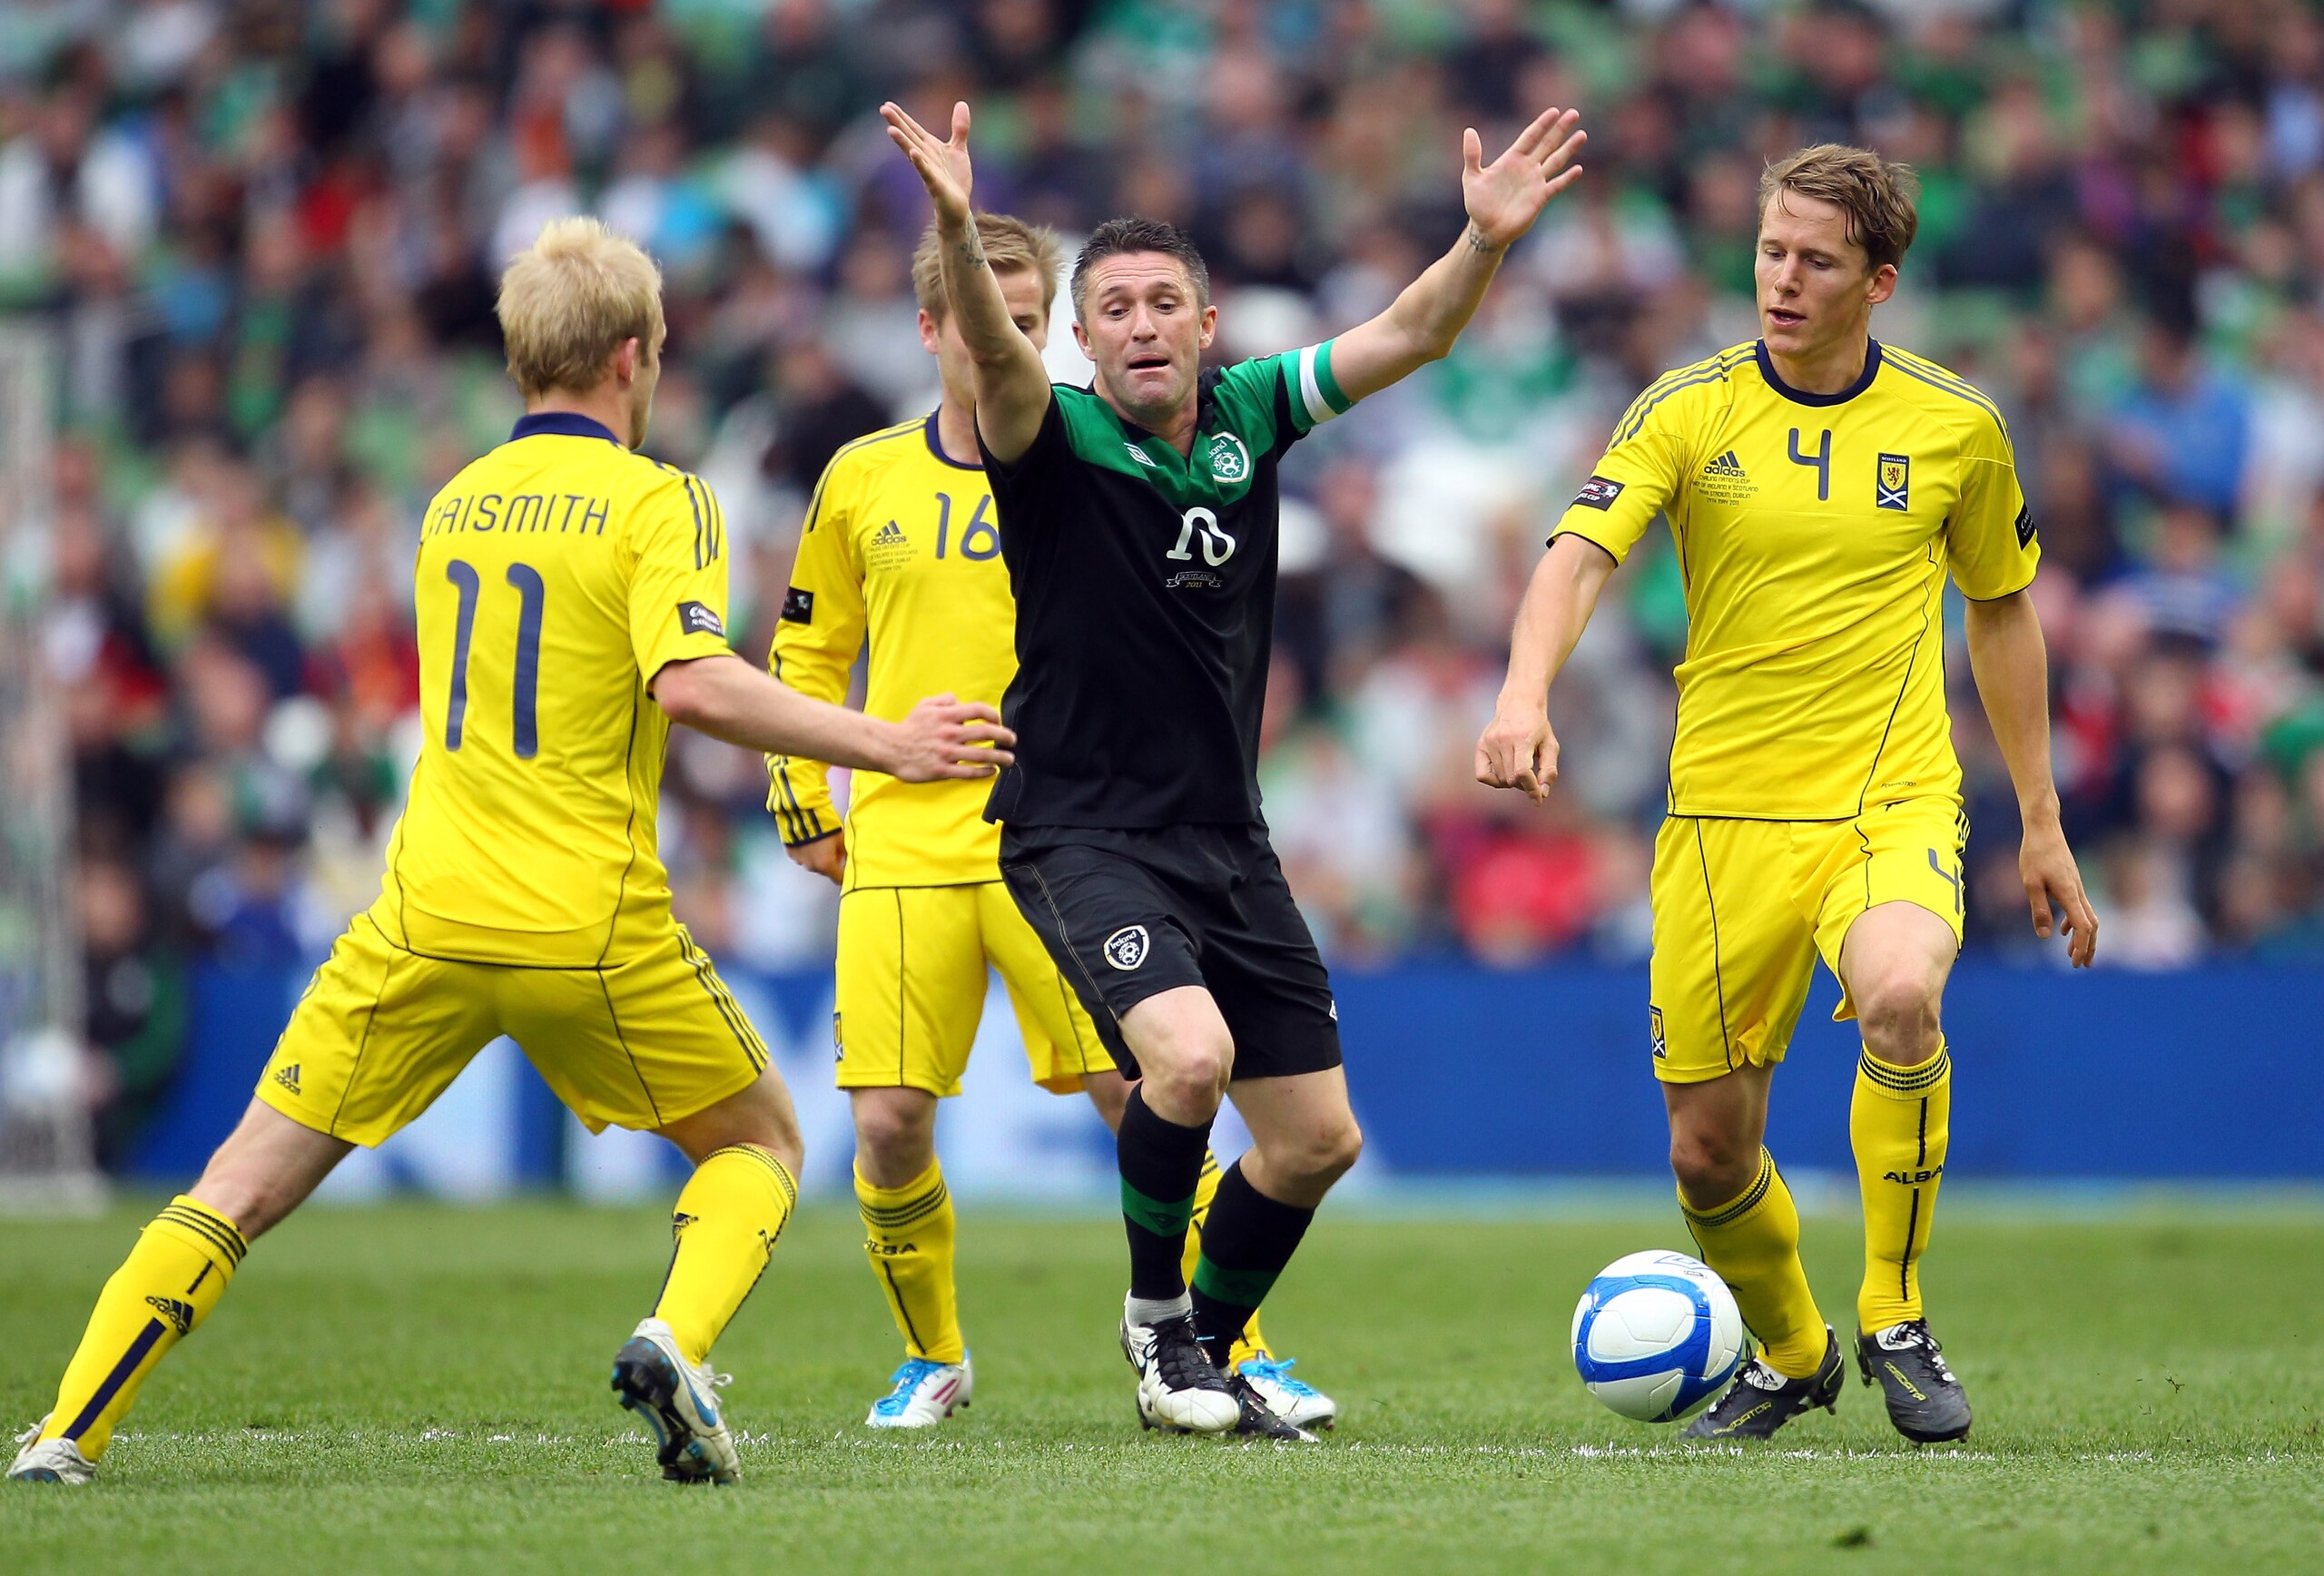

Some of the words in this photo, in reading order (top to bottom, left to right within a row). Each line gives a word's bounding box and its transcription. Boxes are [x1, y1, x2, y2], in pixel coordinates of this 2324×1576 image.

[1208, 438, 1227, 458] land
[1787, 428, 1831, 501] 4
[1704, 465, 1745, 477] adidas
[872, 536, 907, 547] adidas
[935, 492, 1001, 561] 16
[1166, 507, 1236, 566] 10
[446, 559, 545, 761] 11
[1927, 848, 1960, 916] 4
[1109, 930, 1137, 950] Ireland
[1883, 1164, 1943, 1184] ALBA
